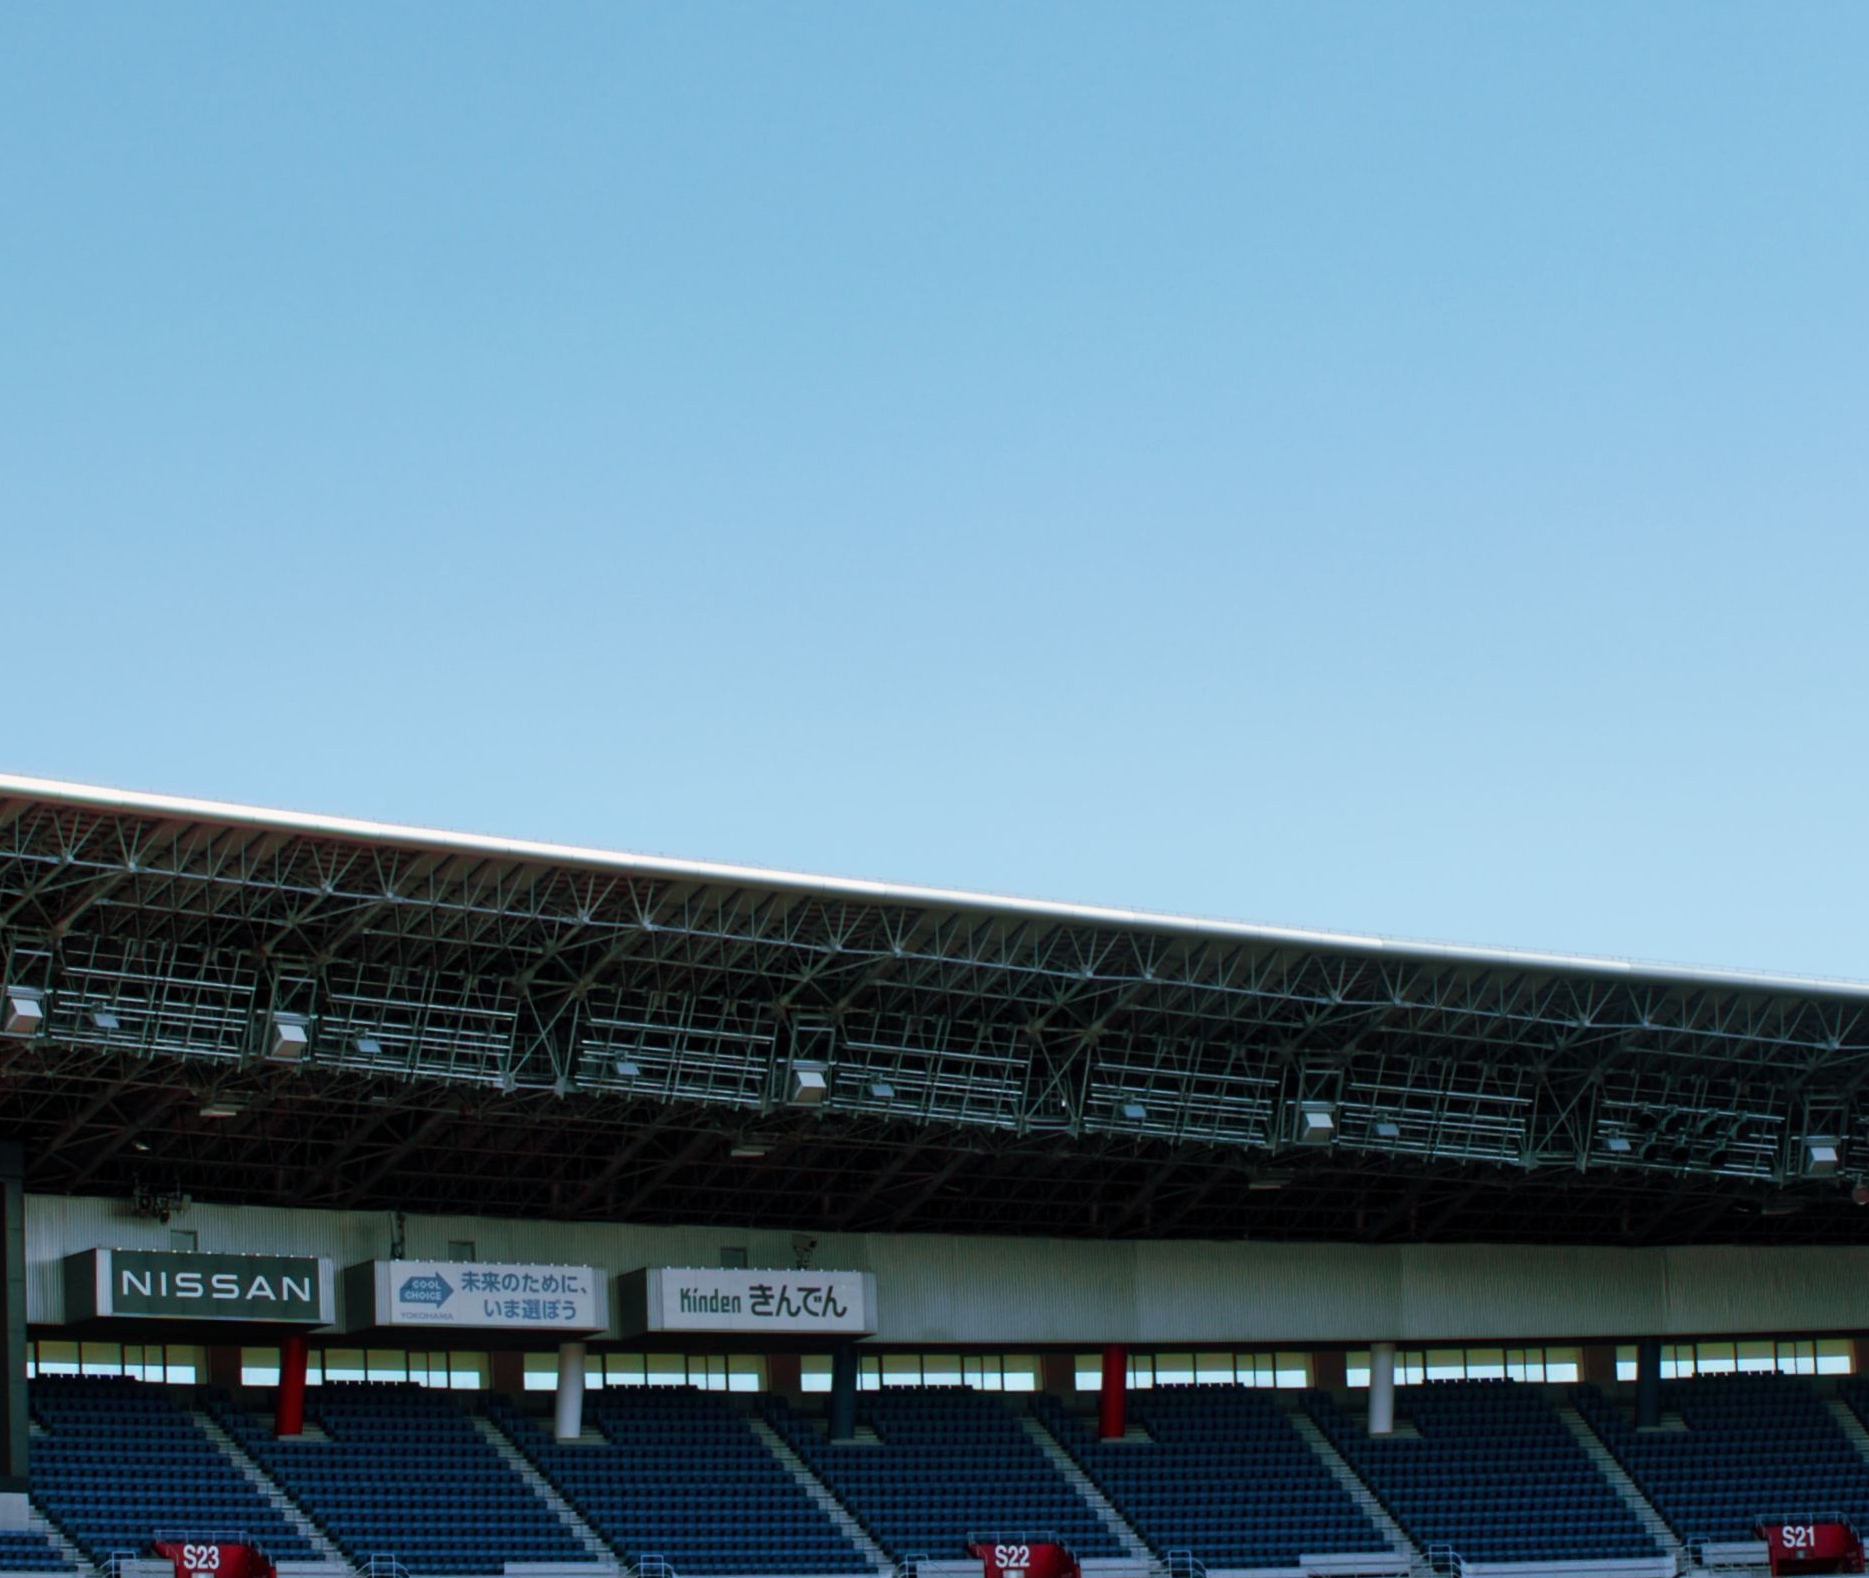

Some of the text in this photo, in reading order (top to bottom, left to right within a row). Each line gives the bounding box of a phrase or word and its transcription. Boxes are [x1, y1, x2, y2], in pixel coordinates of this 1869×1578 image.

[121, 1270, 311, 1302] NISSAN
[412, 1279, 441, 1290] COOL
[461, 1271, 589, 1294] 未来のために、
[404, 1290, 442, 1301] CHOICE
[679, 1284, 848, 1317] Kinden きんでん
[400, 1311, 454, 1321] YOKOHAMA
[484, 1298, 577, 1320] いま選ぼう
[1782, 1526, 1815, 1548] S21
[183, 1545, 220, 1570] S23
[995, 1545, 1030, 1568] S22
